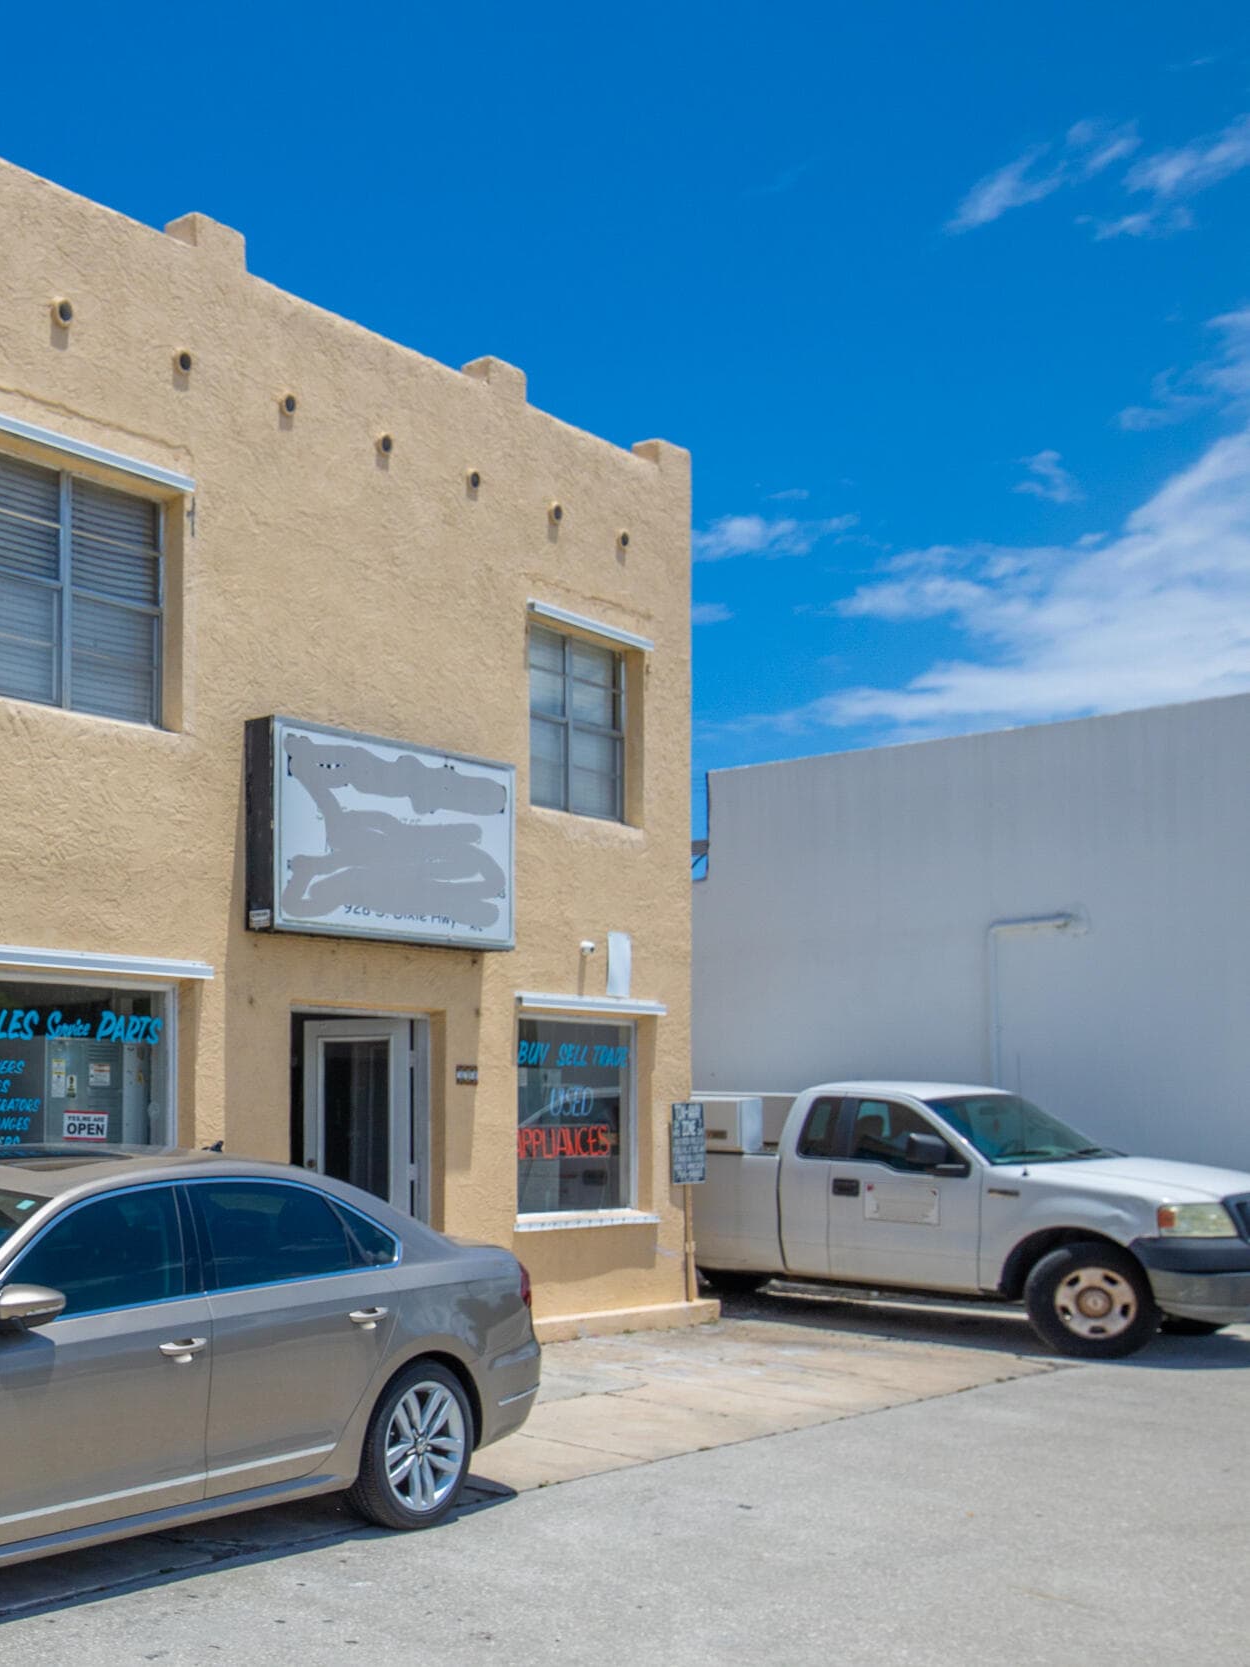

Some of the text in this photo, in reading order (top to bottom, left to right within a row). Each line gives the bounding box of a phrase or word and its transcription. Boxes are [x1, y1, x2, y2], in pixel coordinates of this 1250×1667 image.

[45, 1010, 91, 1041] Service
[95, 1010, 163, 1045] PARTS
[517, 1039, 629, 1068] BUY SELL TRADE
[550, 1086, 594, 1117] USED
[66, 1122, 105, 1136] OPEN
